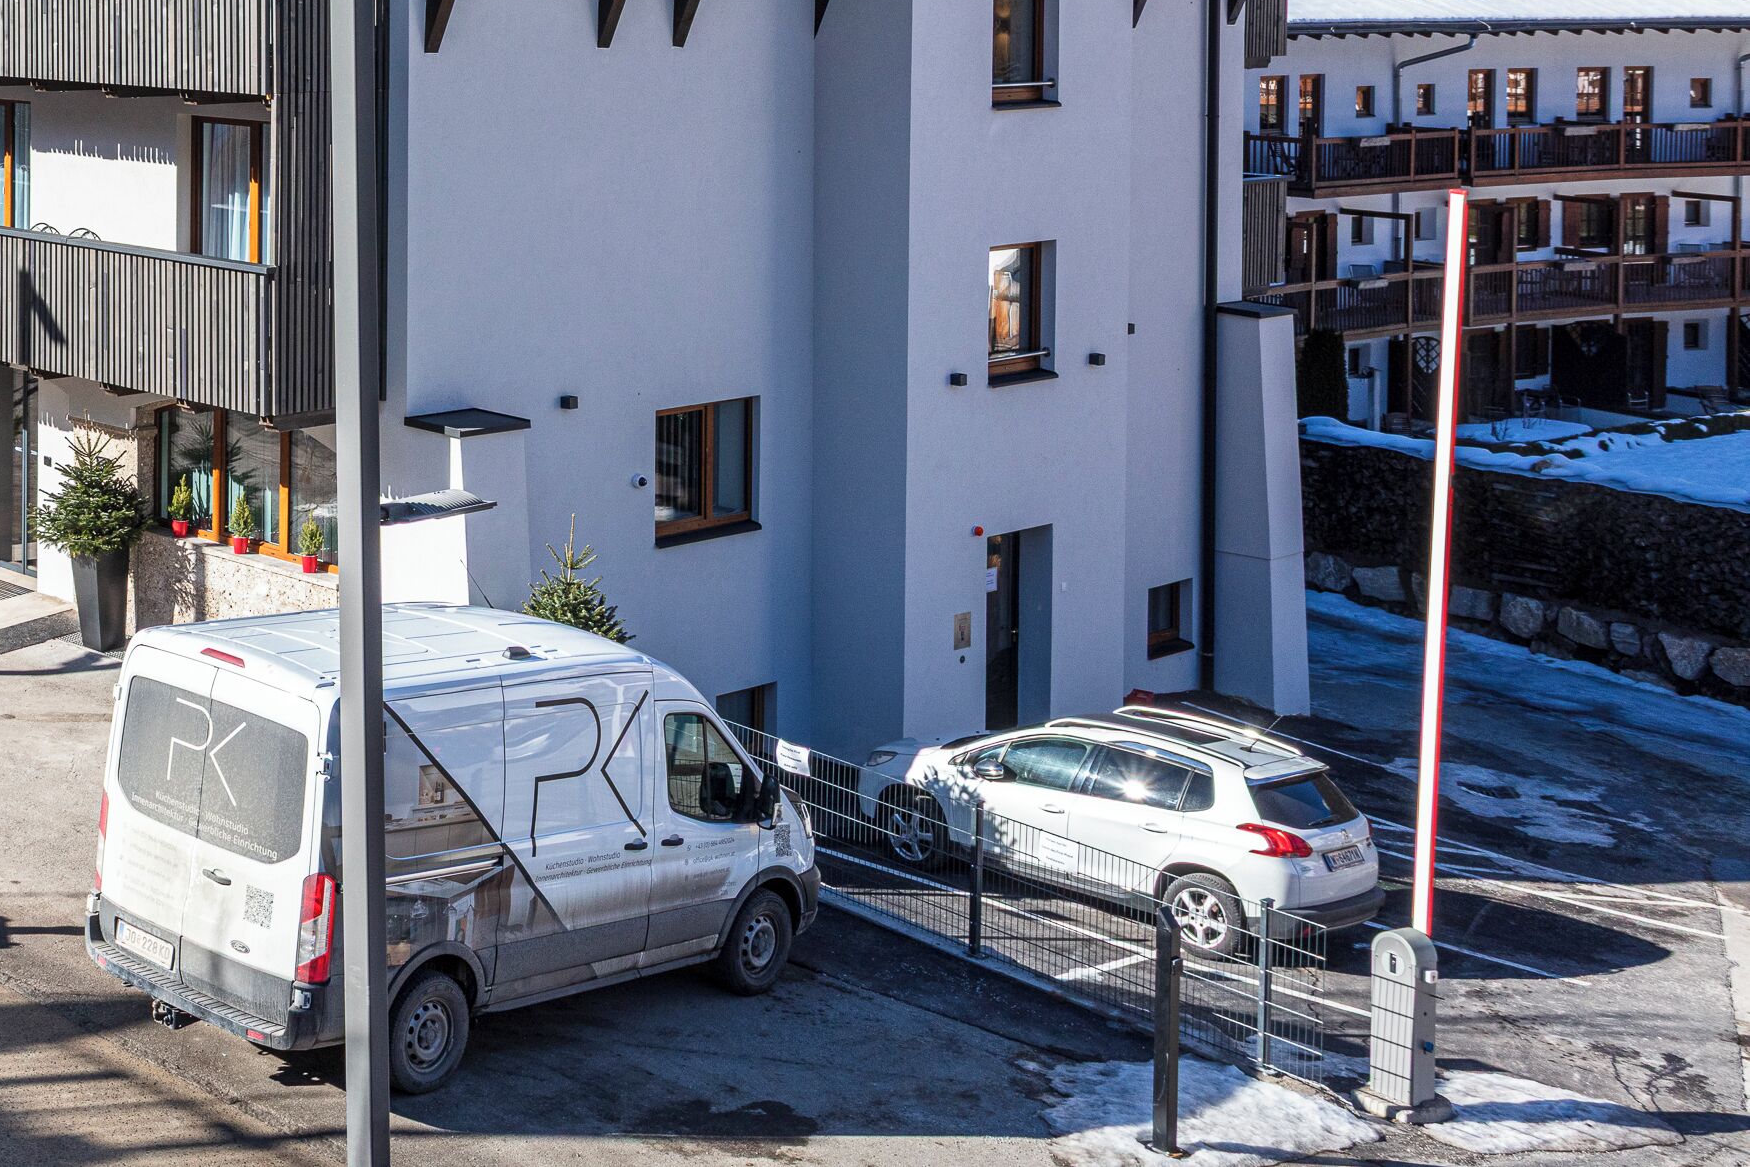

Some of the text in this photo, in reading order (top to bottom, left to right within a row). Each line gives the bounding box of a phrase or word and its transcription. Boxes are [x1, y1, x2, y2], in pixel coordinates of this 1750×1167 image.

[131, 791, 184, 822] Innenarchitektur
[188, 818, 232, 842] Gewerbliche
[233, 835, 278, 861] Einrichtung
[204, 811, 249, 835] Wohnstudio
[587, 851, 621, 864] Wohnstudio
[535, 858, 652, 883] Innenarchitektur Gewerbliche Einrichtung
